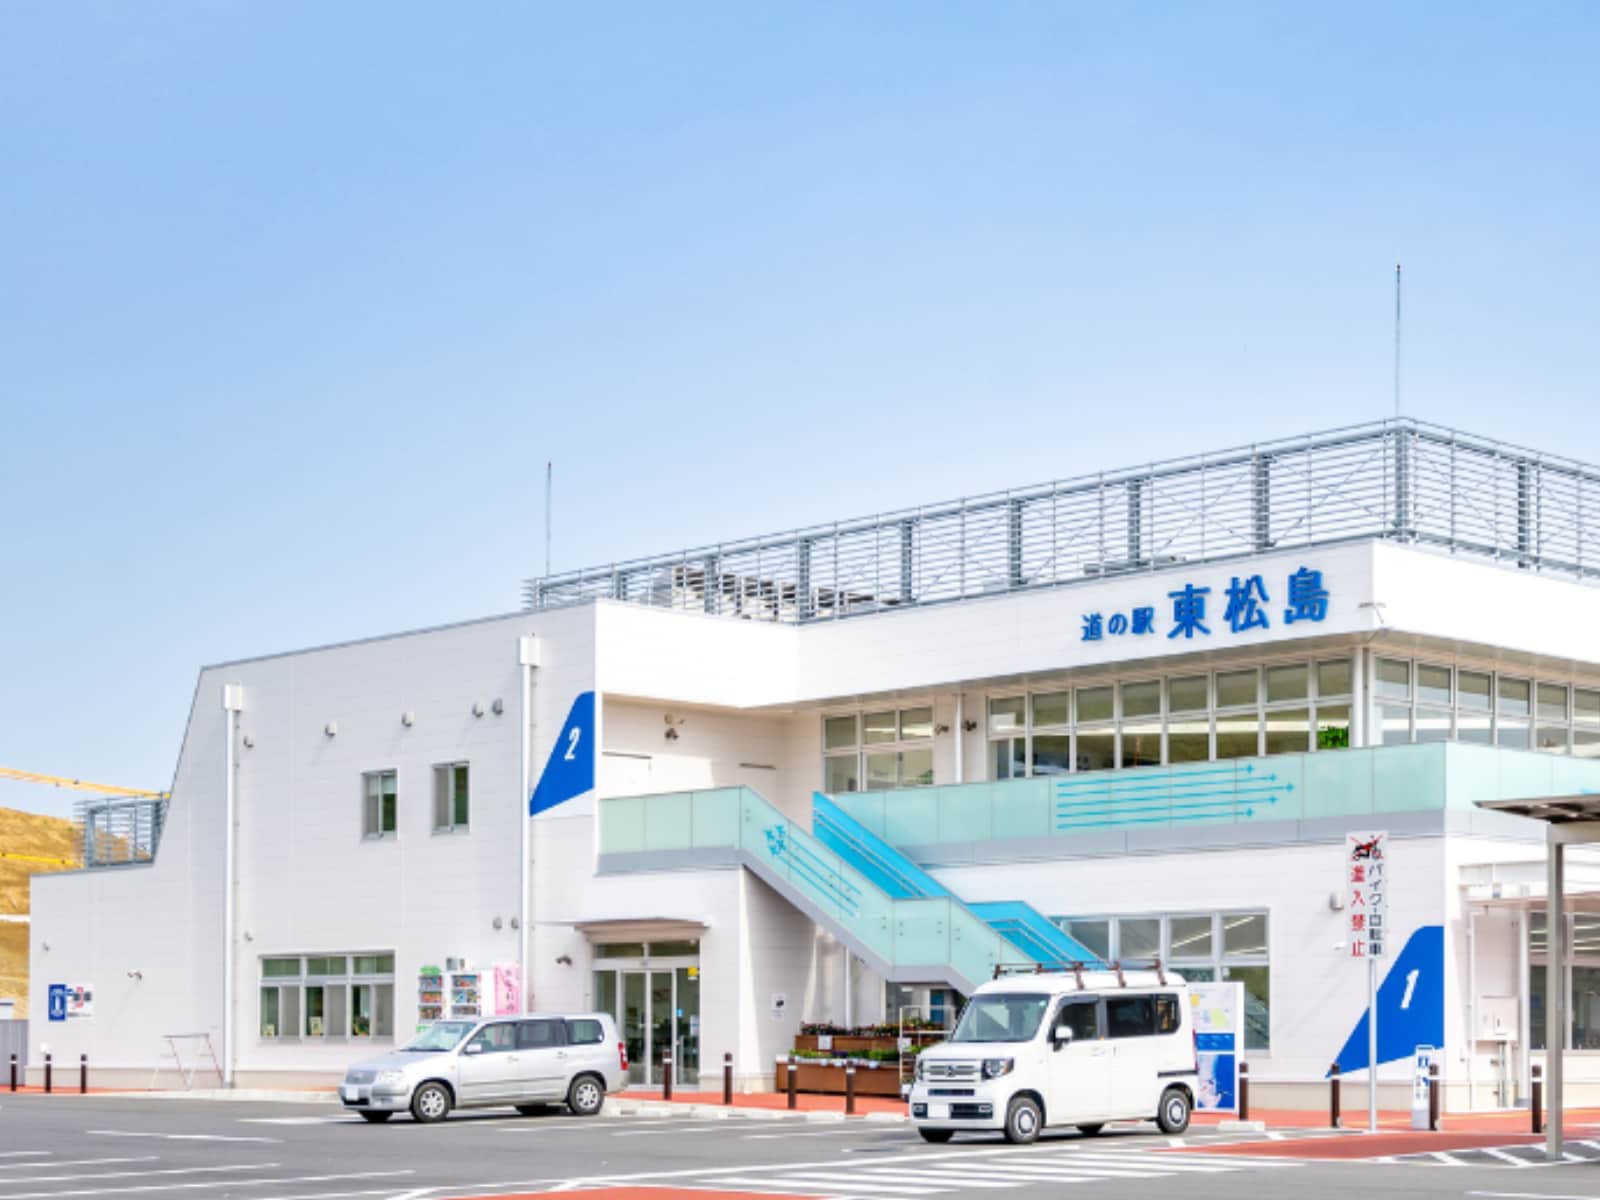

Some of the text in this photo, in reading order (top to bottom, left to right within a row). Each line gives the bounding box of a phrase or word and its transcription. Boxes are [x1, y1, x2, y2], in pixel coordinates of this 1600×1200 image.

[1081, 566, 1329, 641] 道の駅 東松島
[564, 727, 580, 760] 2
[1400, 969, 1420, 1009] 1
